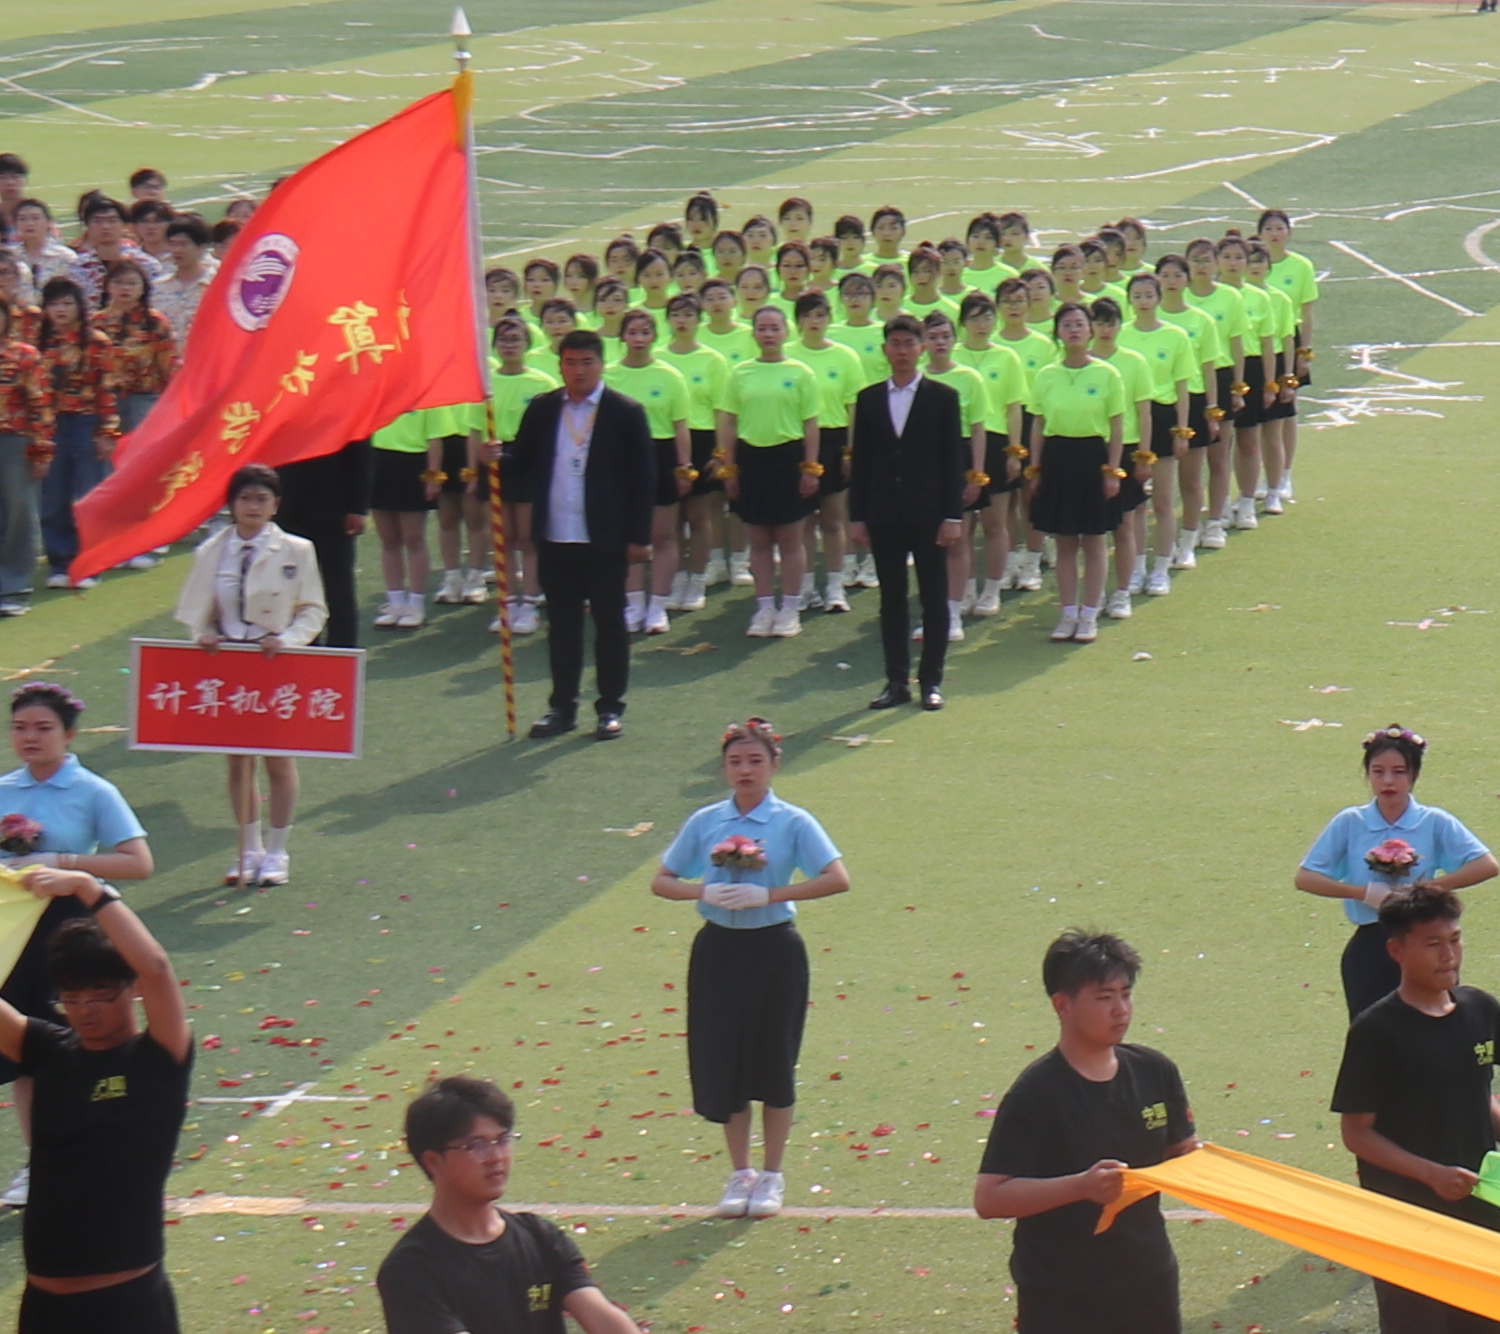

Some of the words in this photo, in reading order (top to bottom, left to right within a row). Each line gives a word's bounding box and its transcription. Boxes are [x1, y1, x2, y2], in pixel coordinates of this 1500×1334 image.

[146, 678, 346, 722] 计算机学院
